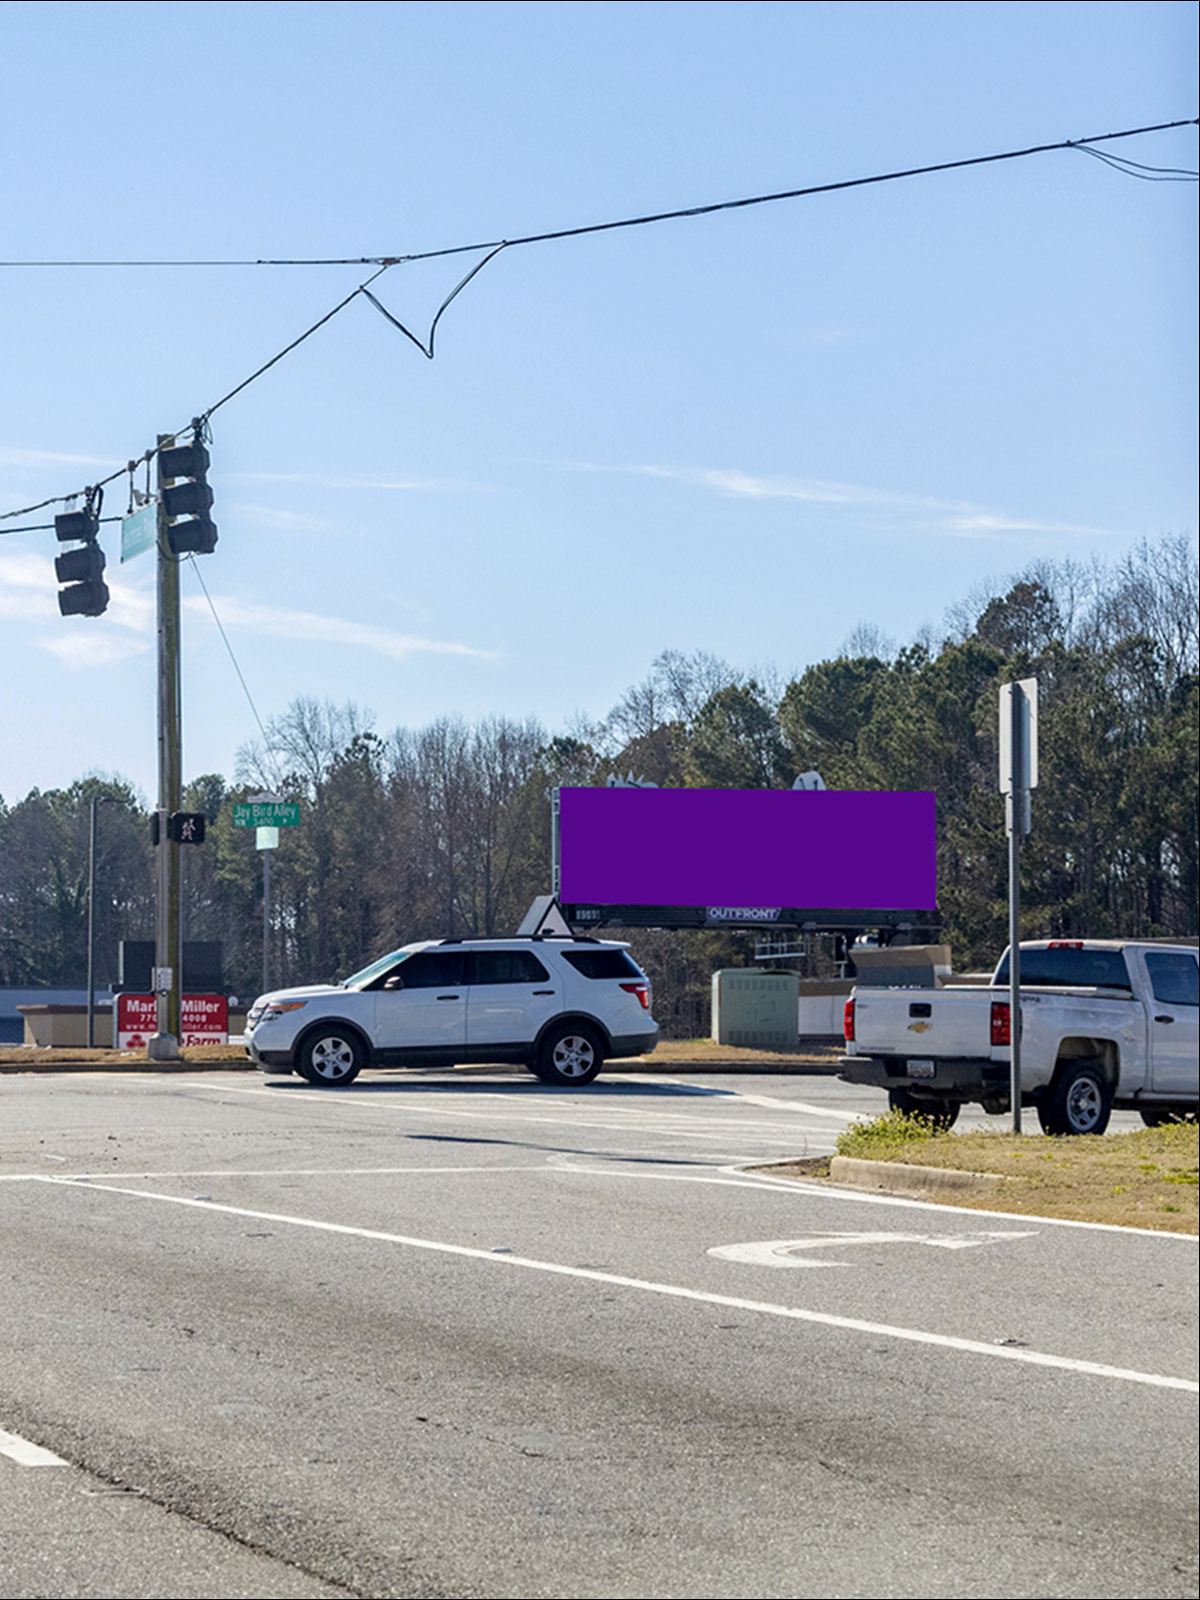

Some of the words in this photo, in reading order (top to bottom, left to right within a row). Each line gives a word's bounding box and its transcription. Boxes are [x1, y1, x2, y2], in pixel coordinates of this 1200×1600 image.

[252, 804, 272, 817] Bird
[273, 803, 296, 819] Alley
[709, 907, 777, 918] OUTFRONT
[181, 1000, 220, 1013] Miller
[186, 1034, 221, 1047] Farm
